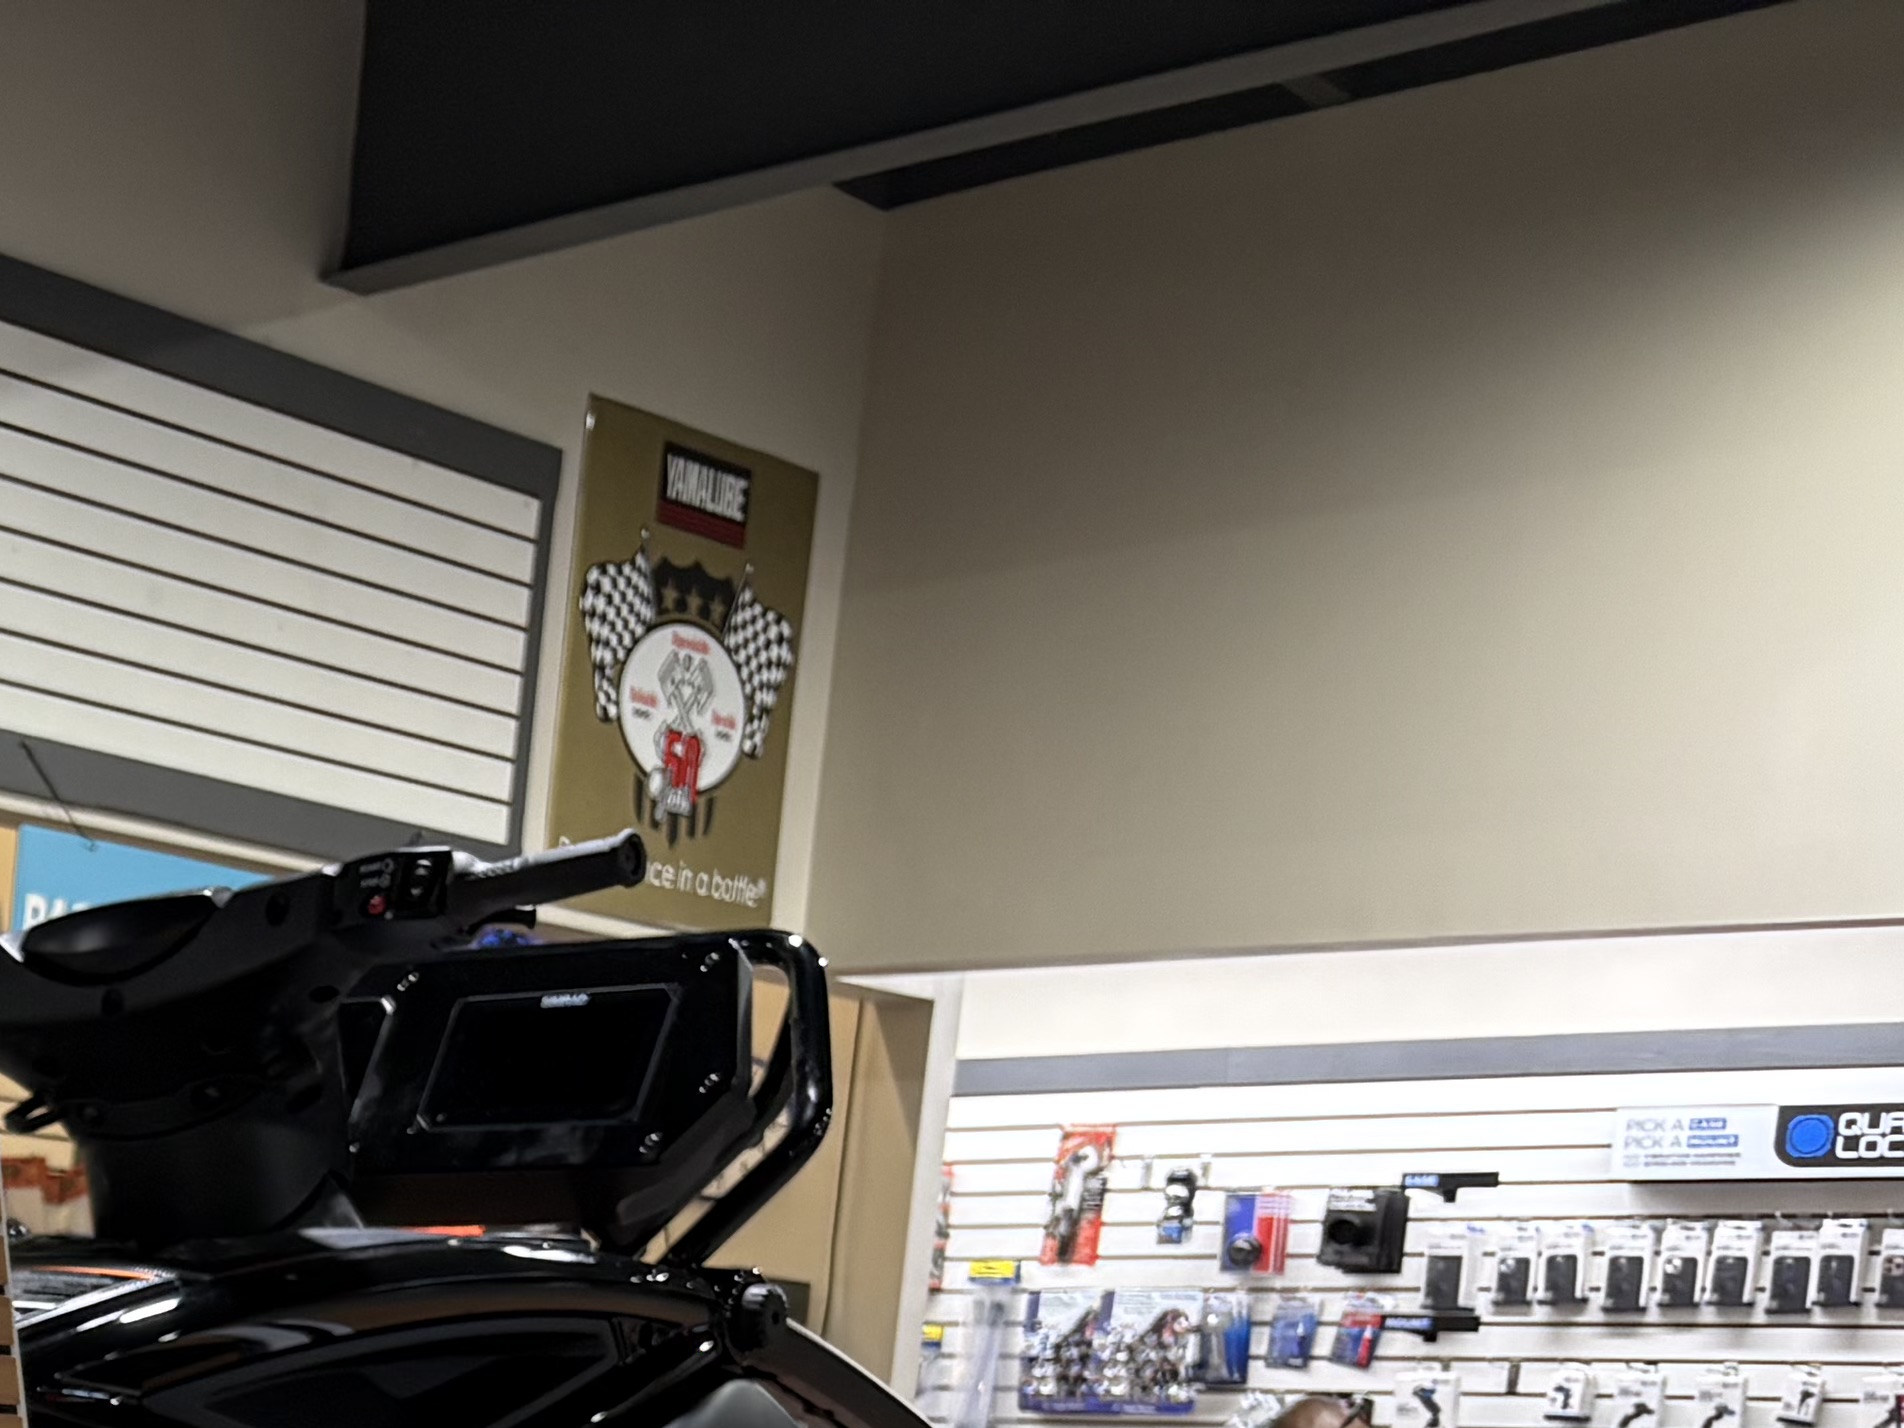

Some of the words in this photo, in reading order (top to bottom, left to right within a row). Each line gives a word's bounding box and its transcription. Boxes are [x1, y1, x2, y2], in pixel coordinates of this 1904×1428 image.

[666, 453, 748, 522] YAMALUBE
[1626, 1117, 1667, 1133] PICK
[1624, 1134, 1665, 1150] PICK
